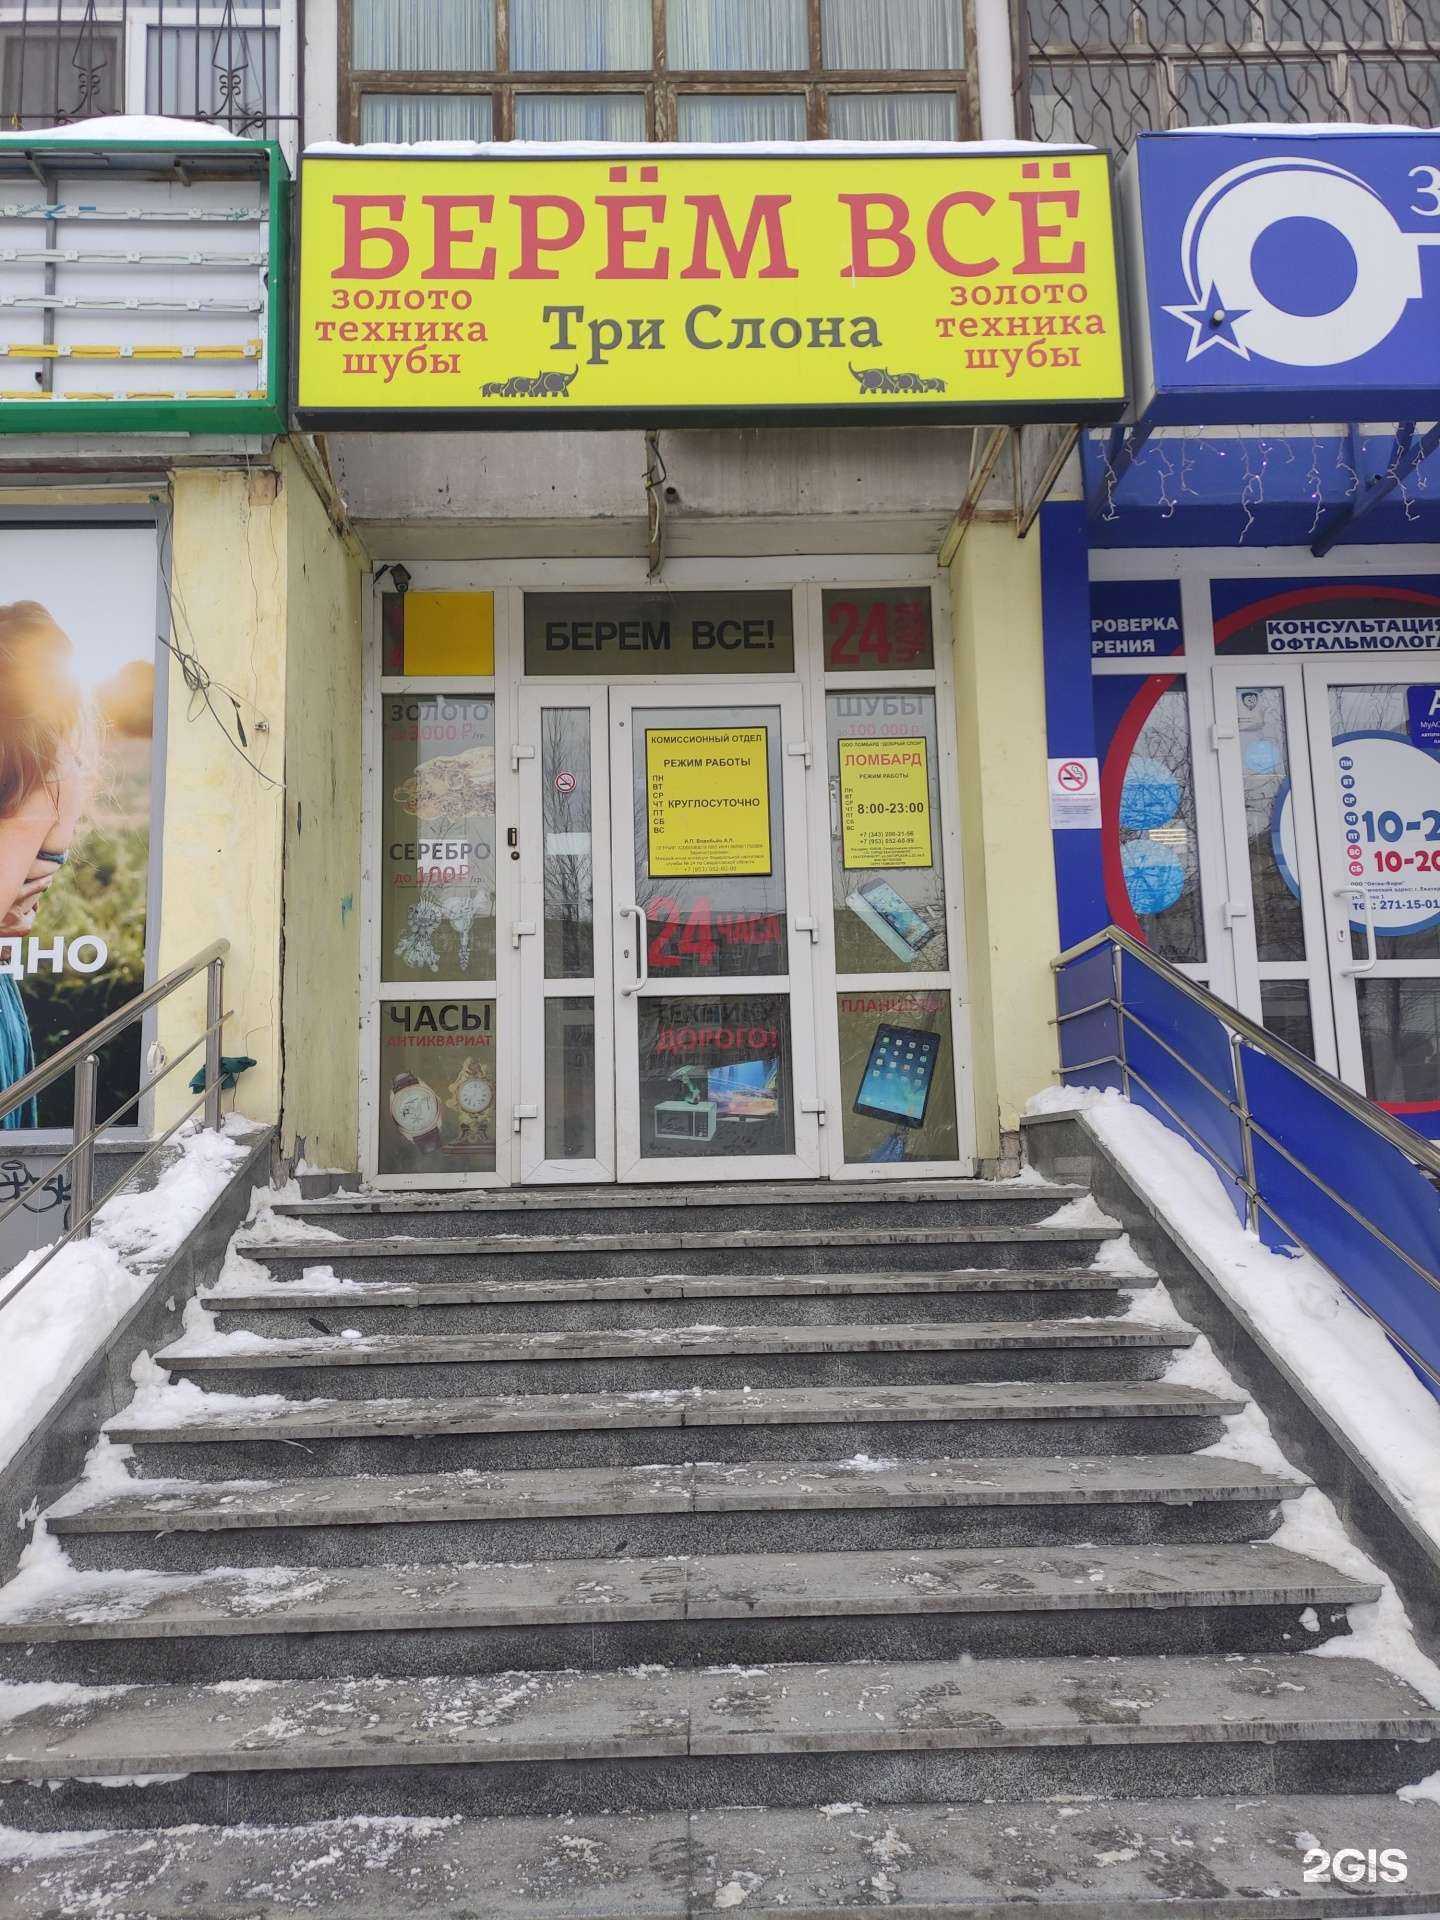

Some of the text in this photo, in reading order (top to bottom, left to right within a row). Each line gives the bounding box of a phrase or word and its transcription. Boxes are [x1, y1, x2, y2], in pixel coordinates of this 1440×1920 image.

[331, 162, 1085, 280] БЕРЁМ ВСЁ
[331, 288, 473, 311] золото
[949, 282, 1089, 307] золото
[315, 320, 489, 343] техника
[543, 304, 882, 365] Три Слона
[935, 313, 1106, 338] техника
[342, 343, 461, 384] шубы
[964, 338, 1082, 378] шубы
[545, 620, 775, 651] БЕРЕМ ВСЕ!
[828, 602, 892, 664] 24
[1091, 616, 1179, 633] РОВЕРКА
[1091, 639, 1155, 654] РЕНИЯ
[1270, 635, 1440, 651] ОФТАЛЬМОЛОГ
[391, 704, 489, 721] ЗОЛОТО
[836, 695, 924, 717] ШУБЫ
[651, 734, 762, 744] КОМИССИОННЫЙ ОТДЕЛ
[664, 757, 751, 768] РЕЖИМ РАБОТЫ
[845, 753, 922, 767] ЛОМБАРД
[668, 798, 760, 809] КРУГЛОСУТОЧНО
[857, 802, 924, 814] 8:00-23:00
[389, 842, 491, 861] СЕРЕБРО
[1380, 900, 1440, 910] 271-15-01
[647, 895, 718, 967] 24
[390, 1003, 491, 1032] ЧАСЫ
[388, 1035, 492, 1048] АНТИКВАРИАТ
